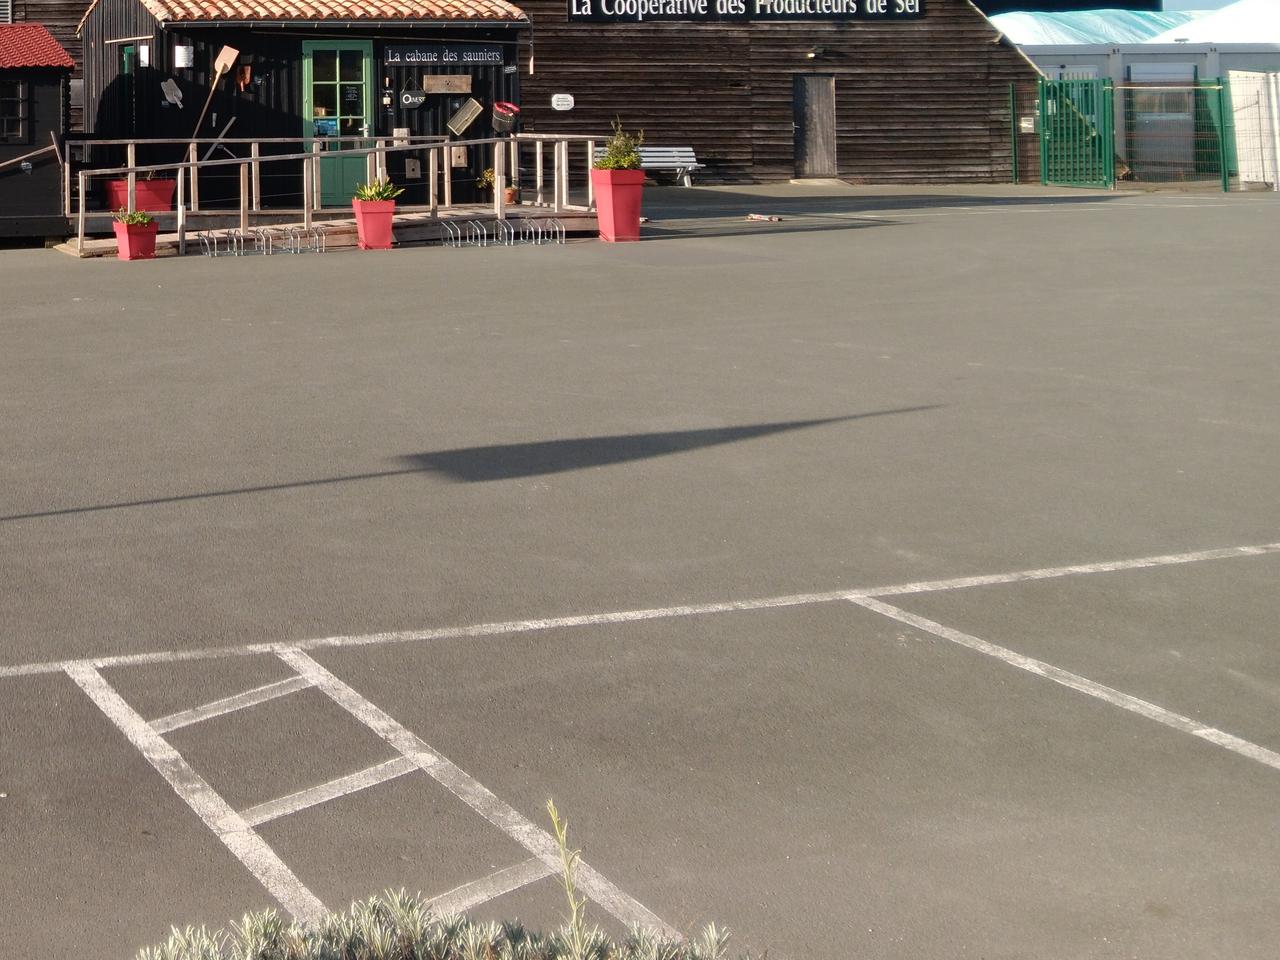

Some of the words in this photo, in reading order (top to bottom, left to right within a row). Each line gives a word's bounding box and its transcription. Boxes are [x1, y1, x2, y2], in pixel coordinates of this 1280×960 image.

[387, 49, 400, 62] La
[405, 49, 438, 62] cabane
[442, 49, 458, 61] des
[463, 48, 500, 61] sauniers
